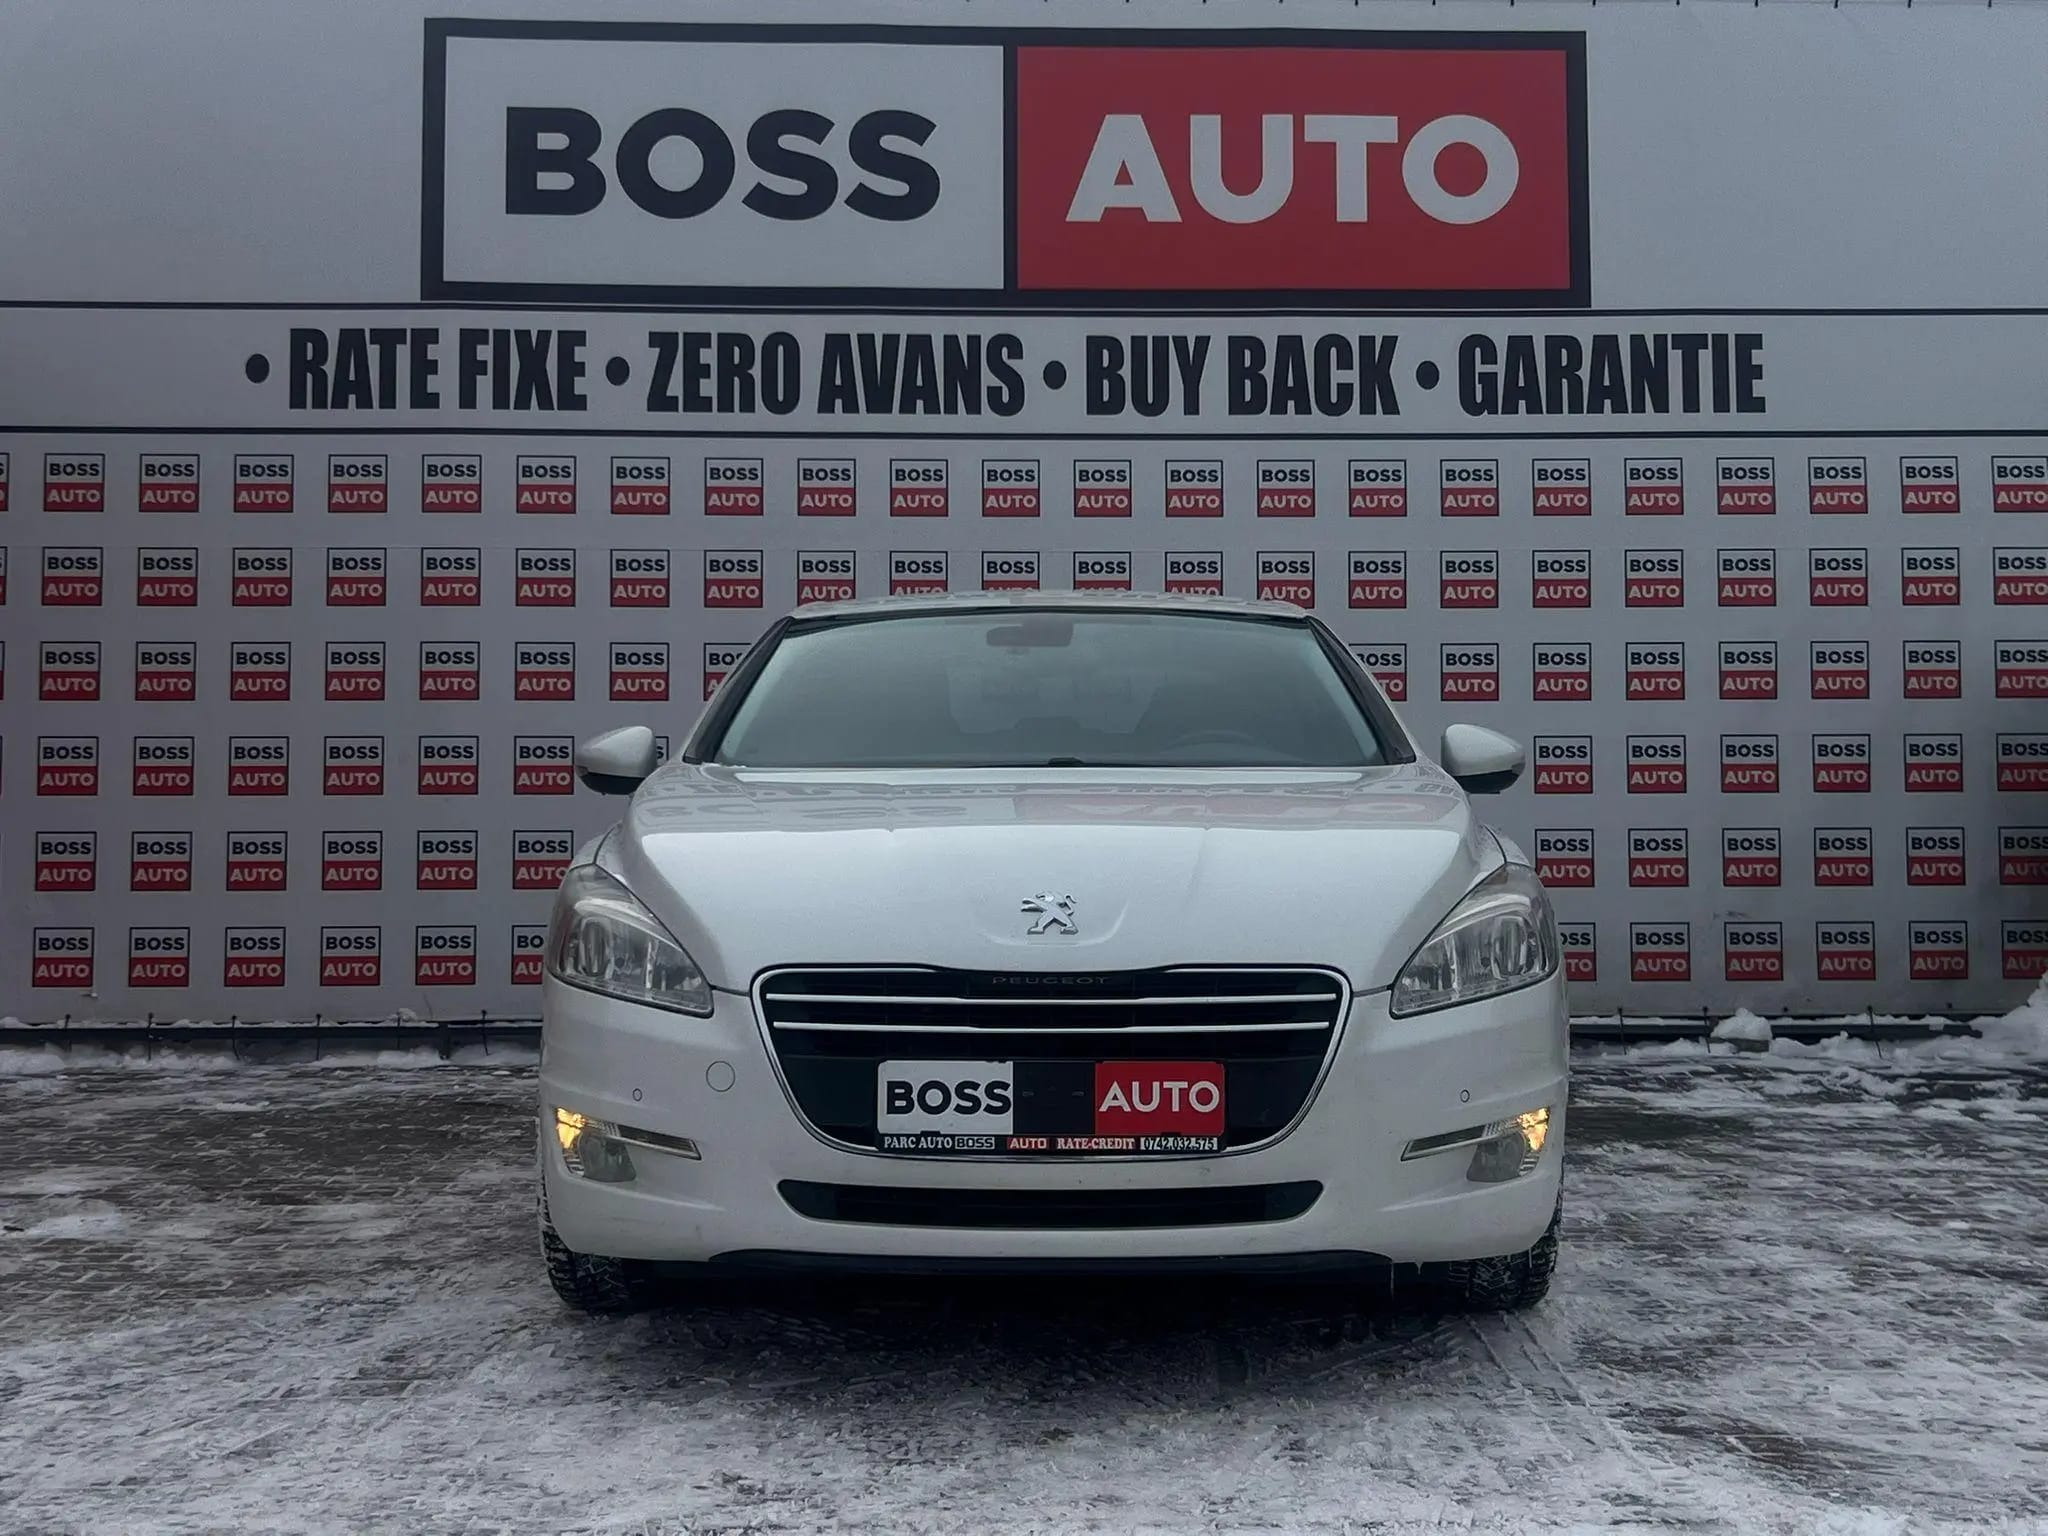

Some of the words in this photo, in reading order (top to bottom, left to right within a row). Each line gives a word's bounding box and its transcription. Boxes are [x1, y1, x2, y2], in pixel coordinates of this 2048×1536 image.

[505, 106, 940, 221] BOSS
[1066, 114, 1519, 224] AUTO
[289, 328, 440, 410] RATE
[459, 328, 587, 411] FIXE
[647, 331, 801, 415] ZERO
[817, 333, 1025, 417] AVANS
[1086, 335, 1211, 417] BUY
[1228, 333, 1400, 417] BACK
[1458, 333, 1766, 417] GARANTIE
[49, 463, 100, 476] BOSS
[145, 464, 195, 477] BOSS
[333, 464, 383, 477] BOSS
[427, 464, 477, 477] BOSS
[522, 465, 571, 478] BOSS
[710, 467, 759, 481] BOSS
[802, 468, 851, 481] BOSS
[895, 468, 944, 482] BOSS
[987, 469, 1035, 482] BOSS
[1170, 469, 1219, 483] BOSS
[1262, 469, 1310, 482] BOSS
[1354, 469, 1402, 482] BOSS
[1537, 468, 1586, 481] BOSS
[1629, 467, 1678, 480] BOSS
[1722, 467, 1770, 480] BOSS
[1905, 466, 1954, 479] BOSS
[1997, 465, 2045, 478] BOSS
[47, 489, 101, 503] AUTO
[142, 490, 195, 503] AUTO
[331, 490, 384, 504] AUTO
[425, 490, 478, 503] AUTO
[520, 491, 573, 504] AUTO
[708, 493, 760, 507] AUTO
[801, 494, 852, 507] AUTO
[893, 494, 945, 507] AUTO
[985, 495, 1036, 508] AUTO
[1169, 495, 1220, 508] AUTO
[1261, 495, 1312, 508] AUTO
[1352, 495, 1404, 508] AUTO
[1536, 494, 1588, 507] AUTO
[1628, 493, 1680, 506] AUTO
[1721, 492, 1772, 505] AUTO
[1905, 491, 1956, 504] AUTO
[47, 556, 98, 570] BOSS
[143, 557, 193, 570] BOSS
[332, 557, 382, 571] BOSS
[426, 557, 476, 570] BOSS
[521, 558, 571, 571] BOSS
[615, 558, 665, 572] BOSS
[802, 560, 851, 573] BOSS
[895, 560, 943, 574] BOSS
[987, 561, 1035, 574] BOSS
[1078, 561, 1127, 574] BOSS
[1170, 561, 1218, 574] BOSS
[1262, 560, 1310, 574] BOSS
[1353, 560, 1402, 574] BOSS
[1445, 560, 1494, 573] BOSS
[1537, 559, 1586, 573] BOSS
[1722, 558, 1771, 571] BOSS
[1814, 558, 1863, 571] BOSS
[1907, 557, 1955, 570] BOSS
[1998, 556, 2047, 570] BOSS
[45, 583, 99, 596] AUTO
[140, 584, 194, 597] AUTO
[330, 584, 383, 597] AUTO
[424, 583, 477, 597] AUTO
[520, 584, 572, 597] AUTO
[614, 585, 666, 598] AUTO
[1352, 586, 1403, 599] AUTO
[1444, 586, 1495, 599] AUTO
[1536, 585, 1588, 599] AUTO
[1721, 584, 1773, 597] AUTO
[1813, 584, 1864, 597] AUTO
[1905, 583, 1957, 596] AUTO
[141, 652, 191, 665] BOSS
[236, 652, 286, 665] BOSS
[331, 651, 381, 665] BOSS
[425, 651, 475, 664] BOSS
[615, 652, 665, 665] BOSS
[1446, 653, 1494, 666] BOSS
[1538, 652, 1587, 666] BOSS
[1724, 651, 1773, 664] BOSS
[1816, 650, 1865, 664] BOSS
[1908, 650, 1956, 663] BOSS
[2000, 650, 2047, 663] BOSS
[138, 678, 192, 692] AUTO
[234, 678, 287, 691] AUTO
[328, 678, 381, 691] AUTO
[423, 677, 476, 691] AUTO
[613, 678, 665, 692] AUTO
[1444, 679, 1495, 692] AUTO
[1536, 678, 1588, 692] AUTO
[1723, 677, 1774, 690] AUTO
[1814, 677, 1866, 690] AUTO
[1907, 676, 1958, 689] AUTO
[43, 746, 93, 760] BOSS
[139, 746, 189, 760] BOSS
[329, 746, 379, 759] BOSS
[424, 745, 474, 759] BOSS
[519, 746, 570, 759] BOSS
[1632, 745, 1681, 758] BOSS
[1817, 744, 1866, 757] BOSS
[1909, 743, 1958, 757] BOSS
[40, 772, 95, 786] AUTO
[136, 773, 190, 786] AUTO
[326, 772, 380, 786] AUTO
[421, 772, 475, 785] AUTO
[516, 772, 570, 785] AUTO
[1630, 771, 1683, 784] AUTO
[1817, 770, 1867, 783] AUTO
[1909, 769, 1960, 782] AUTO
[41, 841, 91, 855] BOSS
[137, 841, 187, 855] BOSS
[328, 841, 378, 854] BOSS
[422, 840, 473, 854] BOSS
[518, 840, 569, 853] BOSS
[1540, 838, 1589, 852] BOSS
[1633, 838, 1683, 852] BOSS
[1819, 837, 1868, 851] BOSS
[1911, 836, 1960, 850] BOSS
[38, 868, 92, 882] AUTO
[133, 868, 188, 882] AUTO
[325, 867, 378, 881] AUTO
[420, 867, 474, 880] AUTO
[1632, 864, 1685, 878] AUTO
[1818, 863, 1870, 877] AUTO
[1911, 863, 1962, 876] AUTO
[326, 936, 376, 950] BOSS
[421, 935, 471, 949] BOSS
[1635, 932, 1685, 945] BOSS
[1821, 931, 1870, 945] BOSS
[1914, 930, 1963, 944] BOSS
[38, 937, 89, 951] BOSS
[134, 937, 185, 951] BOSS
[418, 962, 472, 976] AUTO
[1634, 958, 1687, 972] AUTO
[1821, 957, 1872, 971] AUTO
[1913, 956, 1965, 970] AUTO
[35, 964, 89, 978] AUTO
[131, 964, 186, 978] AUTO
[323, 963, 377, 977] AUTO
[886, 1080, 1012, 1115] BOSS
[1099, 1081, 1219, 1112] AUTO
[884, 1136, 916, 1148] PARC
[918, 1136, 952, 1148] AUTO
[956, 1137, 994, 1148] BOSS
[1009, 1137, 1047, 1149] AUTO
